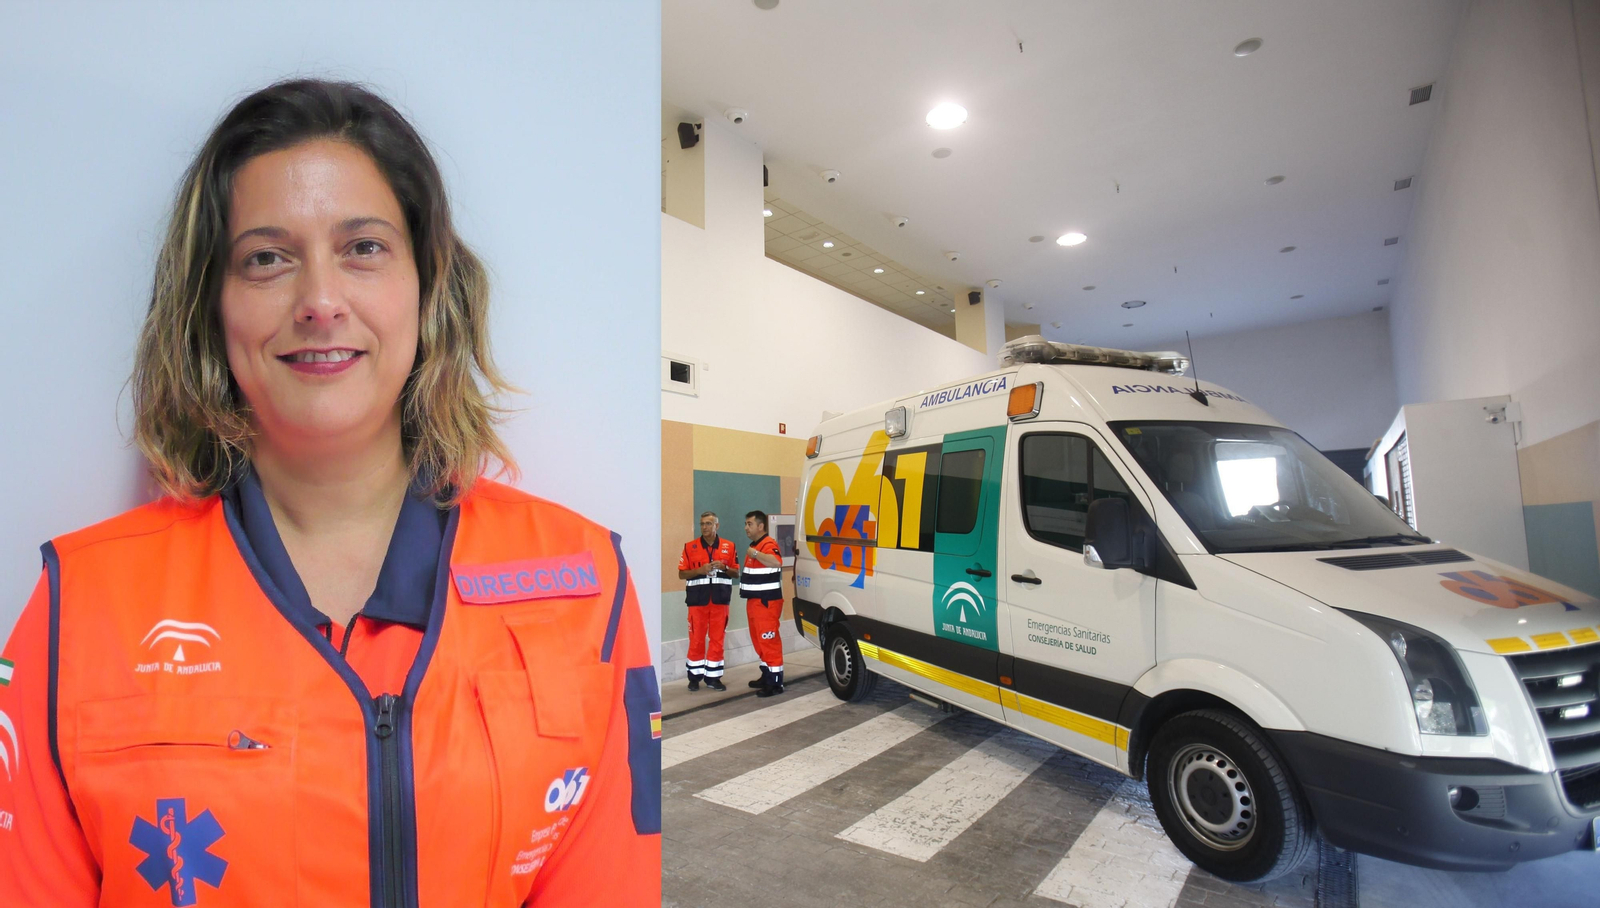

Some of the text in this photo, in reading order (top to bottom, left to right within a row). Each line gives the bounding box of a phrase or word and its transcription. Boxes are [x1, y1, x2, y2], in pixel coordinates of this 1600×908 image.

[920, 377, 1006, 408] AMBULANCIA
[456, 563, 598, 597] DIRECCIÓN
[1027, 618, 1111, 644] Emergencias Sanitarias
[1064, 641, 1074, 650] DE
[1075, 643, 1097, 656] SALUD
[135, 662, 160, 673] JUNTA
[163, 662, 174, 673] DE
